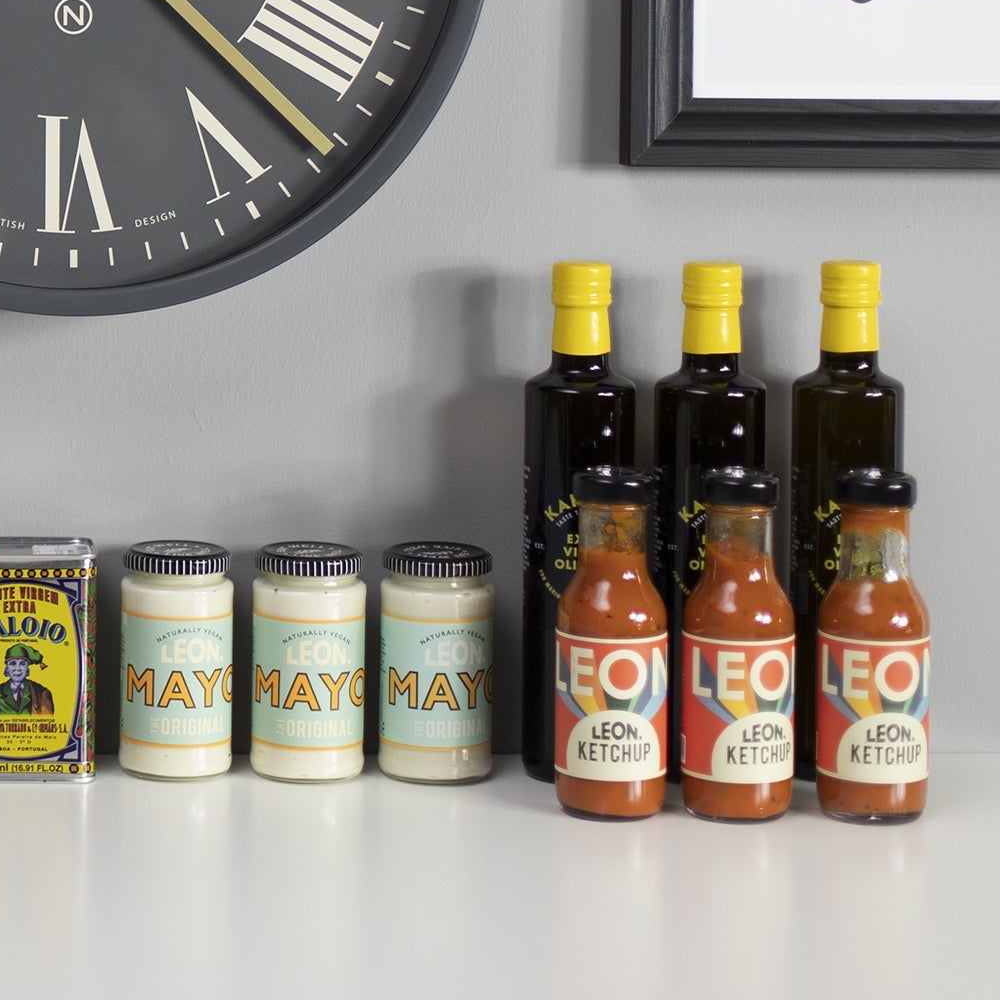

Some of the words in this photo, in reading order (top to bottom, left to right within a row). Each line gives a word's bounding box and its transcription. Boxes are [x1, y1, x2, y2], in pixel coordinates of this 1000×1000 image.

[185, 86, 272, 205] V
[37, 114, 122, 233] VI
[134, 210, 178, 228] DESIGN
[556, 511, 573, 528] TASTE
[554, 559, 577, 570] OLI
[19, 586, 59, 605] VIRGEM
[3, 600, 36, 614] EXTRA
[157, 628, 201, 643] NATURALLY
[204, 629, 223, 641] VEGAN
[282, 630, 327, 644] NATURALLY
[330, 631, 351, 645] VEGAN
[420, 629, 465, 645] NATURALLY
[467, 630, 485, 643] VEGAN
[255, 664, 365, 711] MAYO
[150, 717, 160, 733] THE
[161, 716, 225, 735] ORIGINAL
[287, 718, 352, 738] ORIGINAL
[426, 717, 487, 738] ORIGINAL
[578, 741, 650, 762] KETCHUP
[727, 742, 790, 765] KETCHUP
[851, 743, 921, 765] KETCHUP
[11, 764, 34, 773] (16.91
